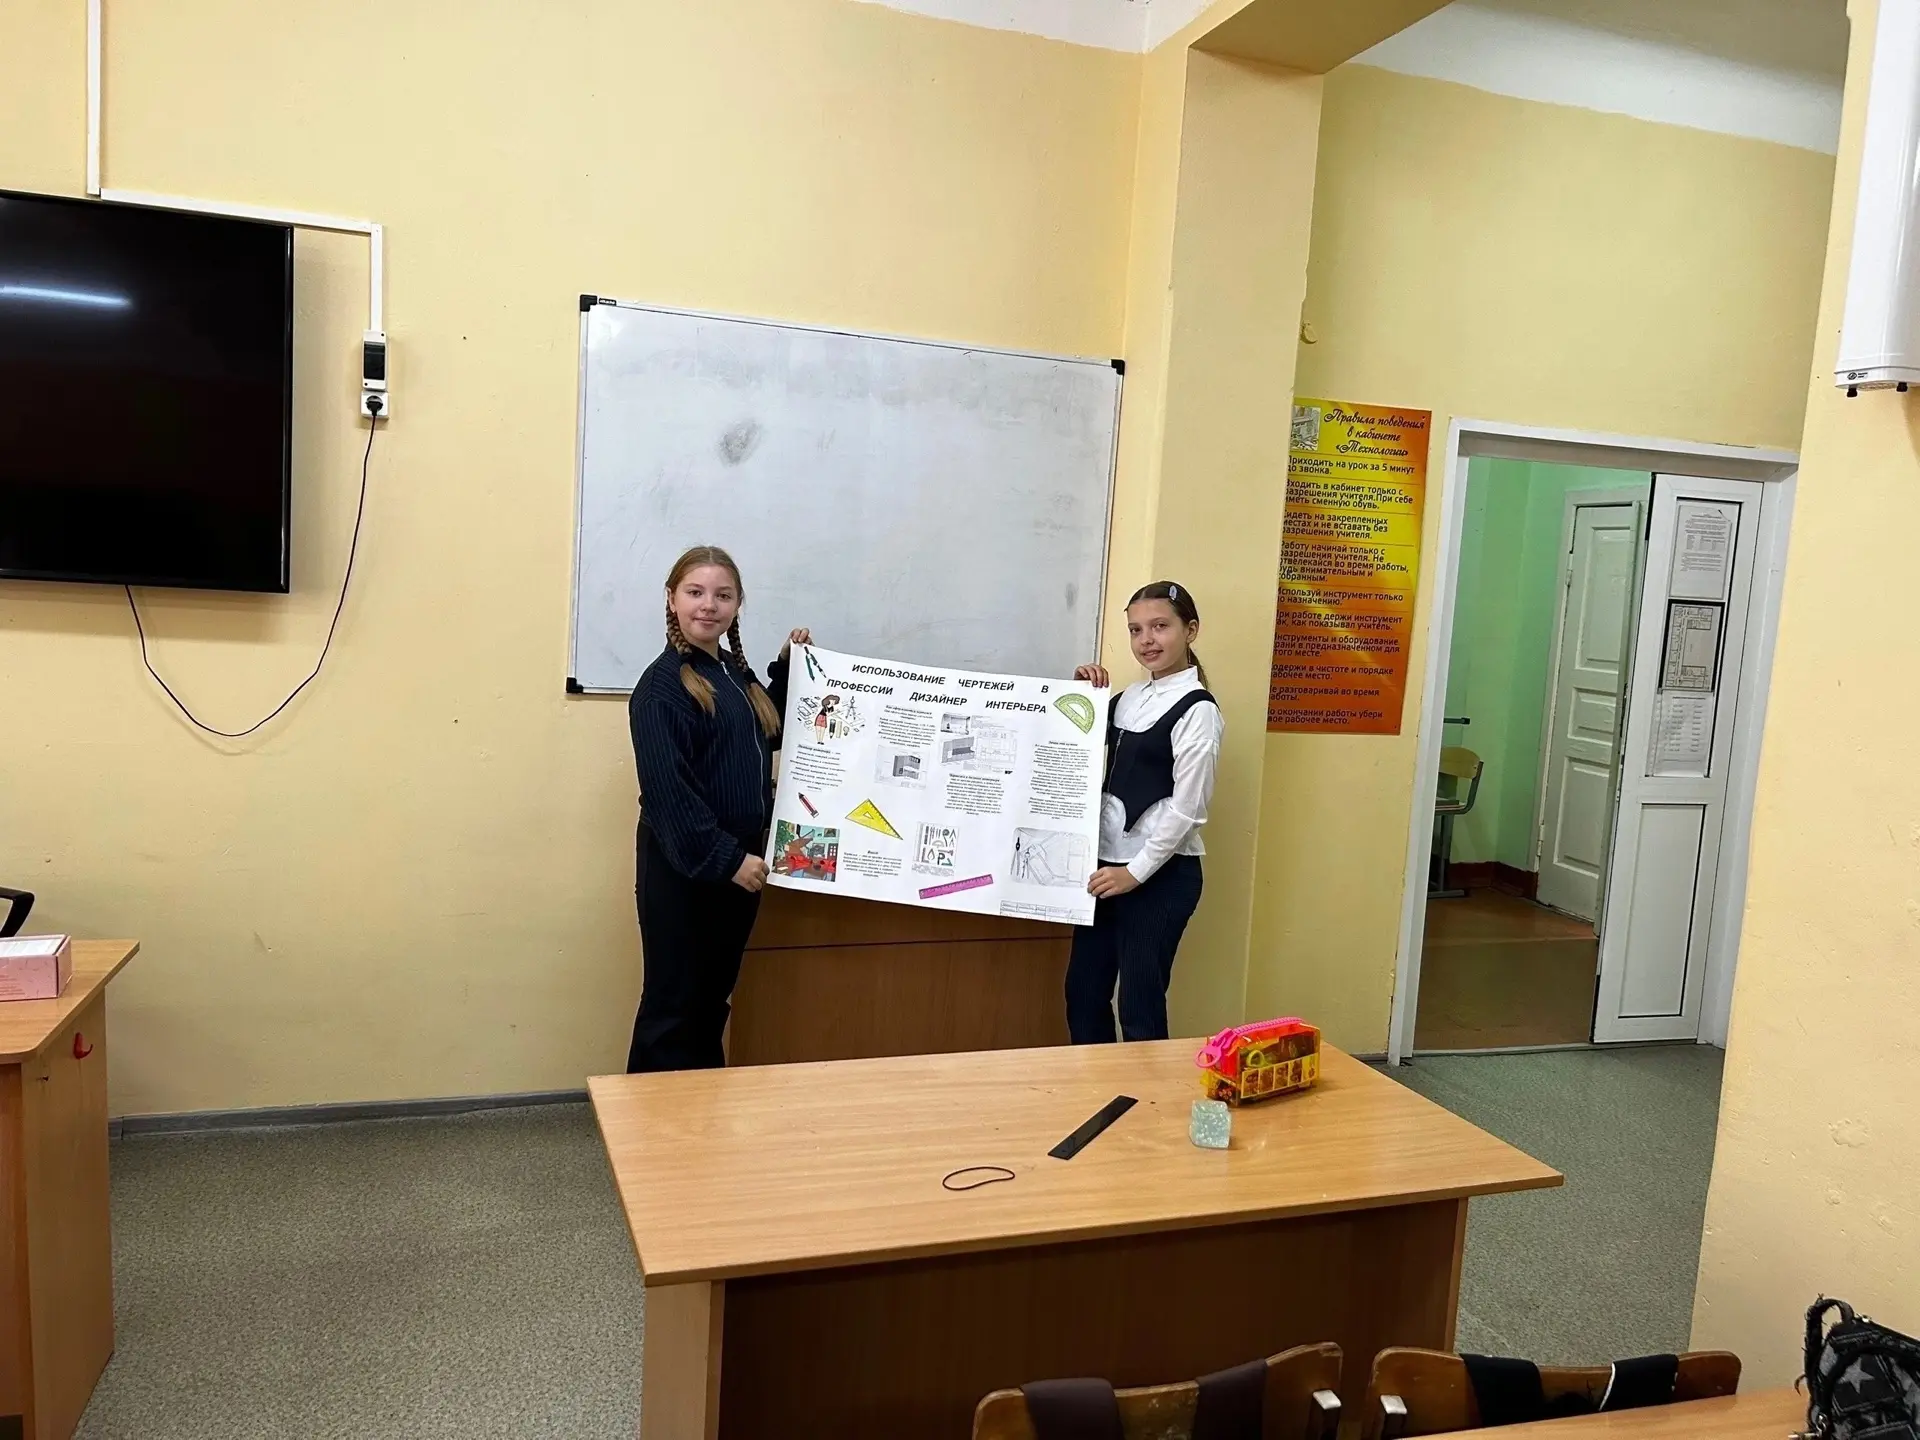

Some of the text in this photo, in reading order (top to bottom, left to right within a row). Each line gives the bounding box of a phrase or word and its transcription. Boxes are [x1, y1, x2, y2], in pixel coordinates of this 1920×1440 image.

[1324, 408, 1425, 429] Правила поведения
[1355, 428, 1402, 441] кабинете
[1299, 466, 1332, 475] звонка.
[1348, 462, 1368, 470] урок
[1389, 465, 1415, 474] минут
[1330, 482, 1365, 492] кабинет
[1367, 486, 1396, 495] только
[1312, 498, 1350, 507] сменную
[1394, 495, 1414, 504] себе
[1327, 514, 1388, 525] закрепленных
[1333, 522, 1371, 531] вставать
[1373, 524, 1388, 532] без
[1311, 544, 1347, 552] начинай
[1349, 547, 1379, 555] только
[1334, 553, 1370, 562] учителя.
[1373, 554, 1384, 562] Не
[1300, 566, 1365, 576] внимательным
[1347, 561, 1374, 569] время
[1376, 563, 1408, 573] работы,
[1287, 596, 1342, 605] назначению.
[1323, 591, 1372, 600] инструмент
[1374, 593, 1404, 601] только
[1292, 611, 1322, 619] работе
[1324, 613, 1352, 622] держи
[1354, 615, 1403, 623] инструмент
[1309, 620, 1355, 628] показывал
[1338, 635, 1398, 646] оборудование
[1274, 641, 1296, 649] рани
[1305, 643, 1382, 652] предназначенном
[1272, 663, 1307, 672] одержи
[1316, 665, 1349, 673] чистоте
[1359, 667, 1394, 675] порядке
[852, 664, 1049, 693] ИСПОЛЬЗОВАНИЕ ЧЕРТЕЖЕЙ В
[1271, 671, 1303, 679] абочее
[826, 678, 1047, 714] ПРОФЕССИИ ДИЗАЙНЕР ИНТЕРЬЕРА
[1269, 693, 1299, 701] аботы.
[1280, 686, 1338, 695] разговаривай
[1353, 689, 1380, 697] время
[1284, 715, 1320, 723] рабочее
[1325, 709, 1356, 717] работы
[1359, 710, 1383, 719] убери
